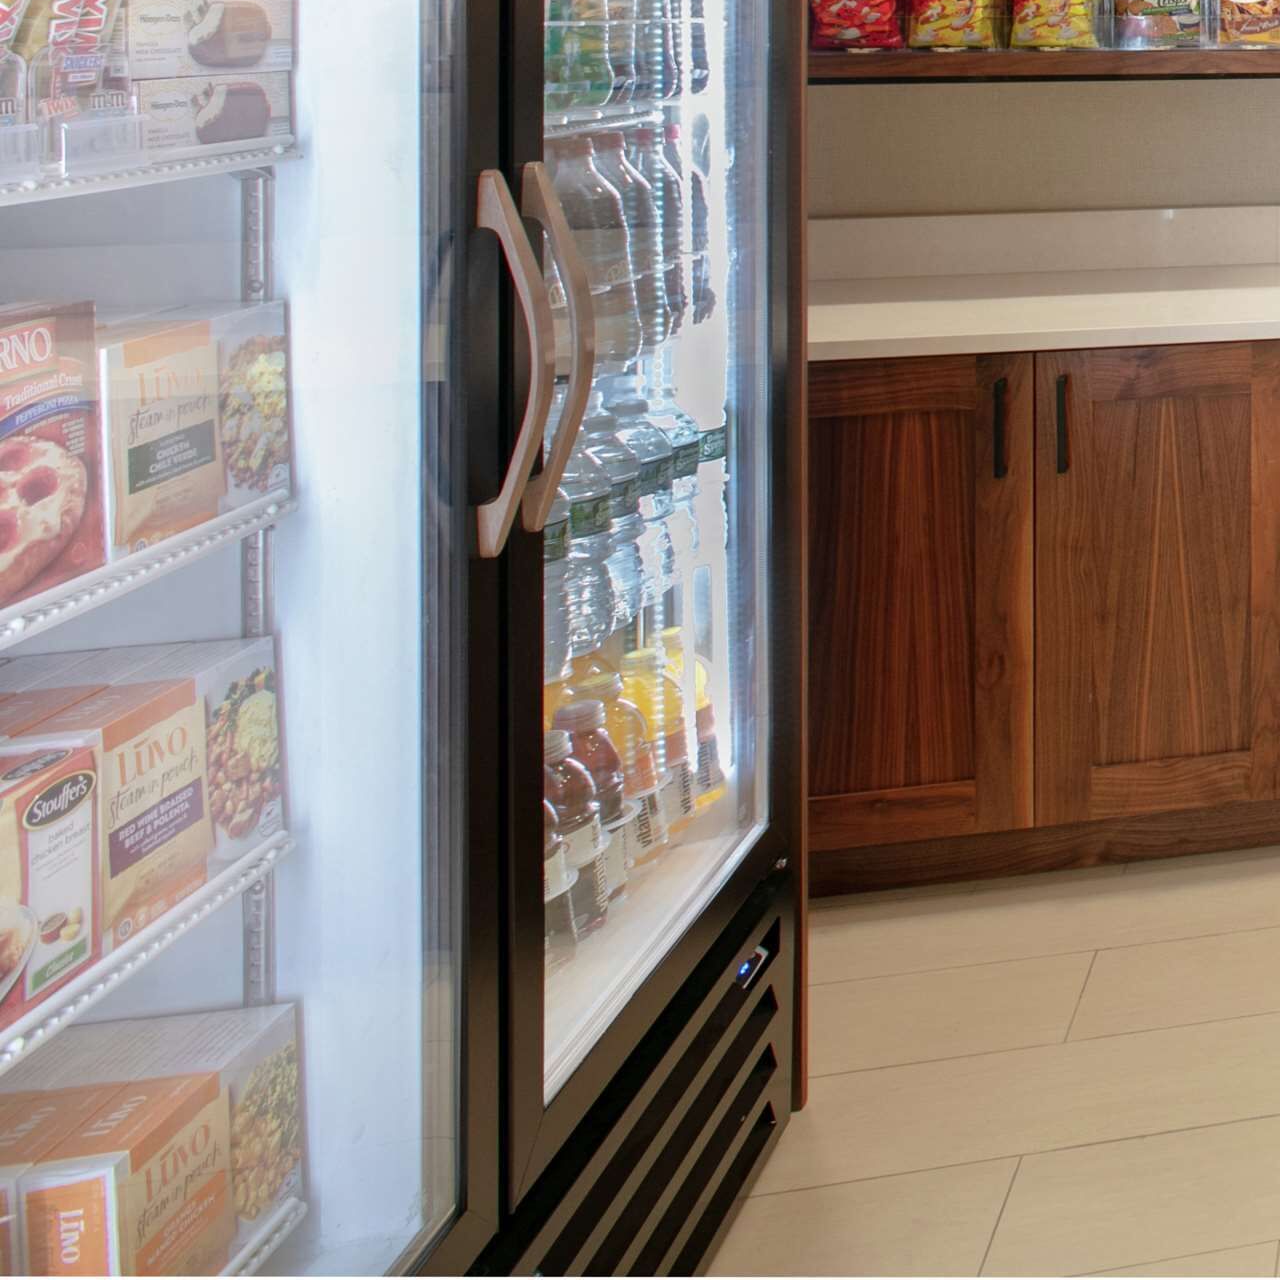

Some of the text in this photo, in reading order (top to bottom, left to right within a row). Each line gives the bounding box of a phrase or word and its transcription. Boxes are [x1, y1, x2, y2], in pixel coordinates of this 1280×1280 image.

[31, 774, 88, 823] Stouffer's
[118, 825, 136, 842] RED
[136, 809, 159, 832] WINE
[158, 786, 195, 814] BRAISED
[31, 840, 64, 867] chicken
[64, 820, 92, 849] breast
[124, 831, 146, 849] BEEF
[152, 802, 190, 830] POLENTA
